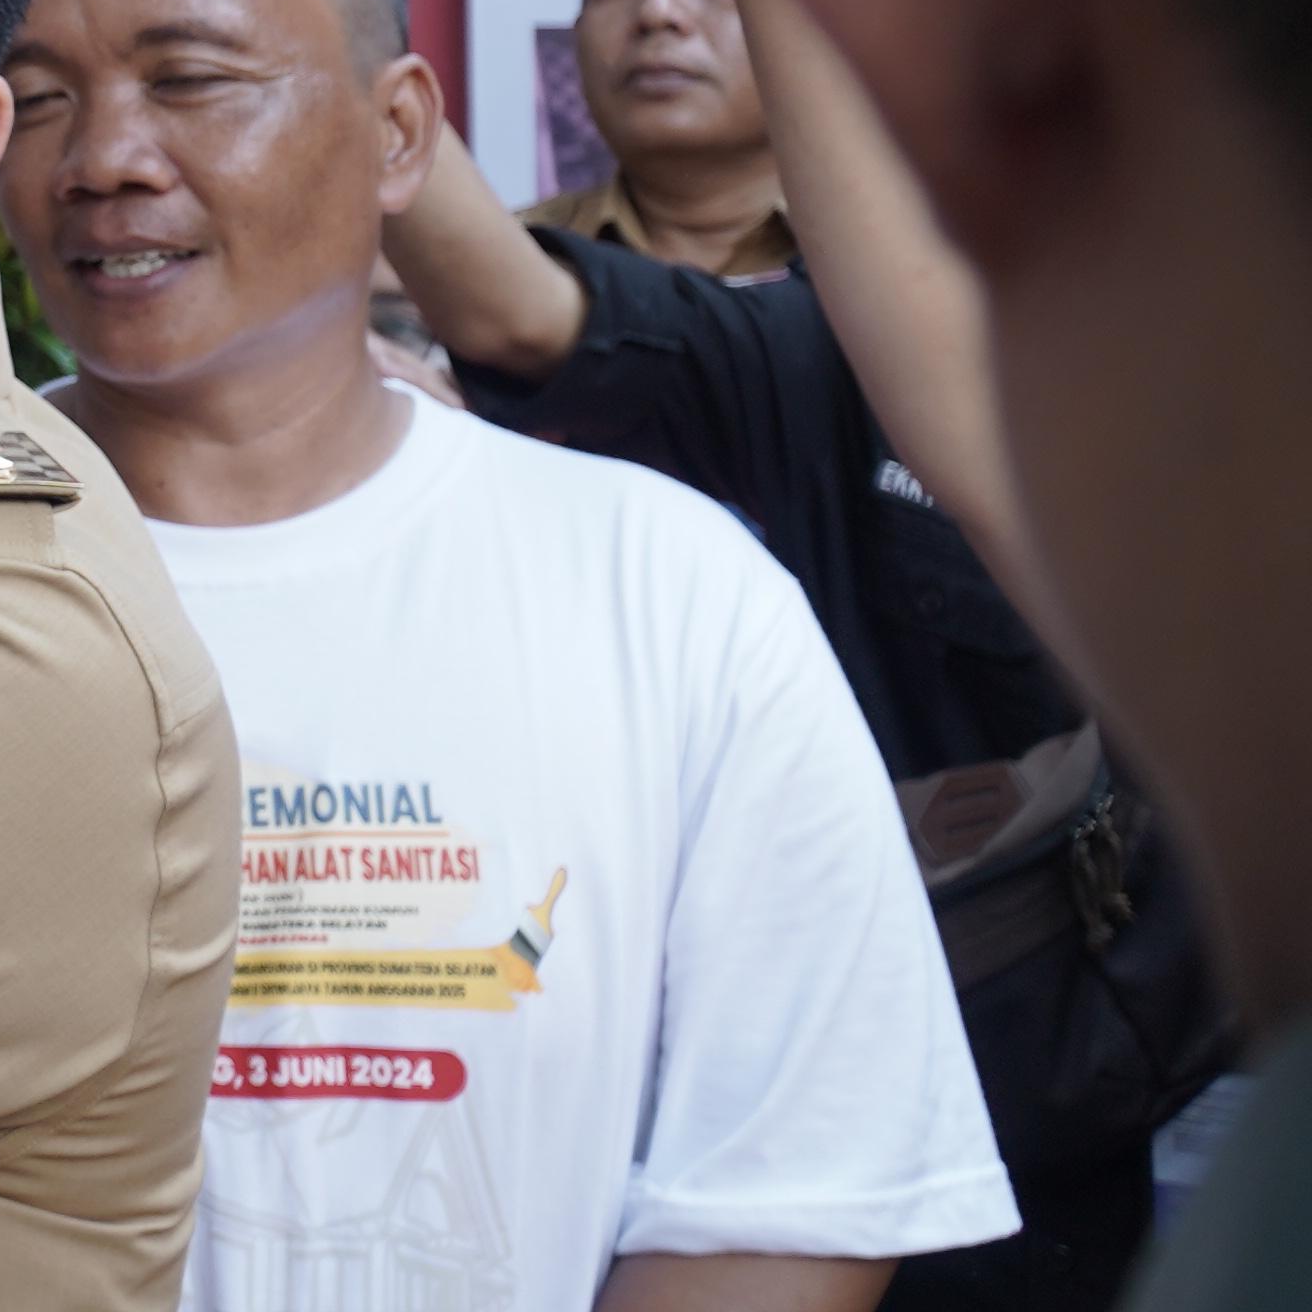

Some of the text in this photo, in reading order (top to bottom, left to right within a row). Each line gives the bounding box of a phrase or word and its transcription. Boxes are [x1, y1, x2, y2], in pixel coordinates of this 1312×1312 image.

[244, 782, 443, 827] EMONIAL
[242, 846, 480, 883] HAN ALAT SANITASI
[444, 961, 497, 977] SELATAN
[212, 1054, 435, 1090] G, 3 JUNI 2024
